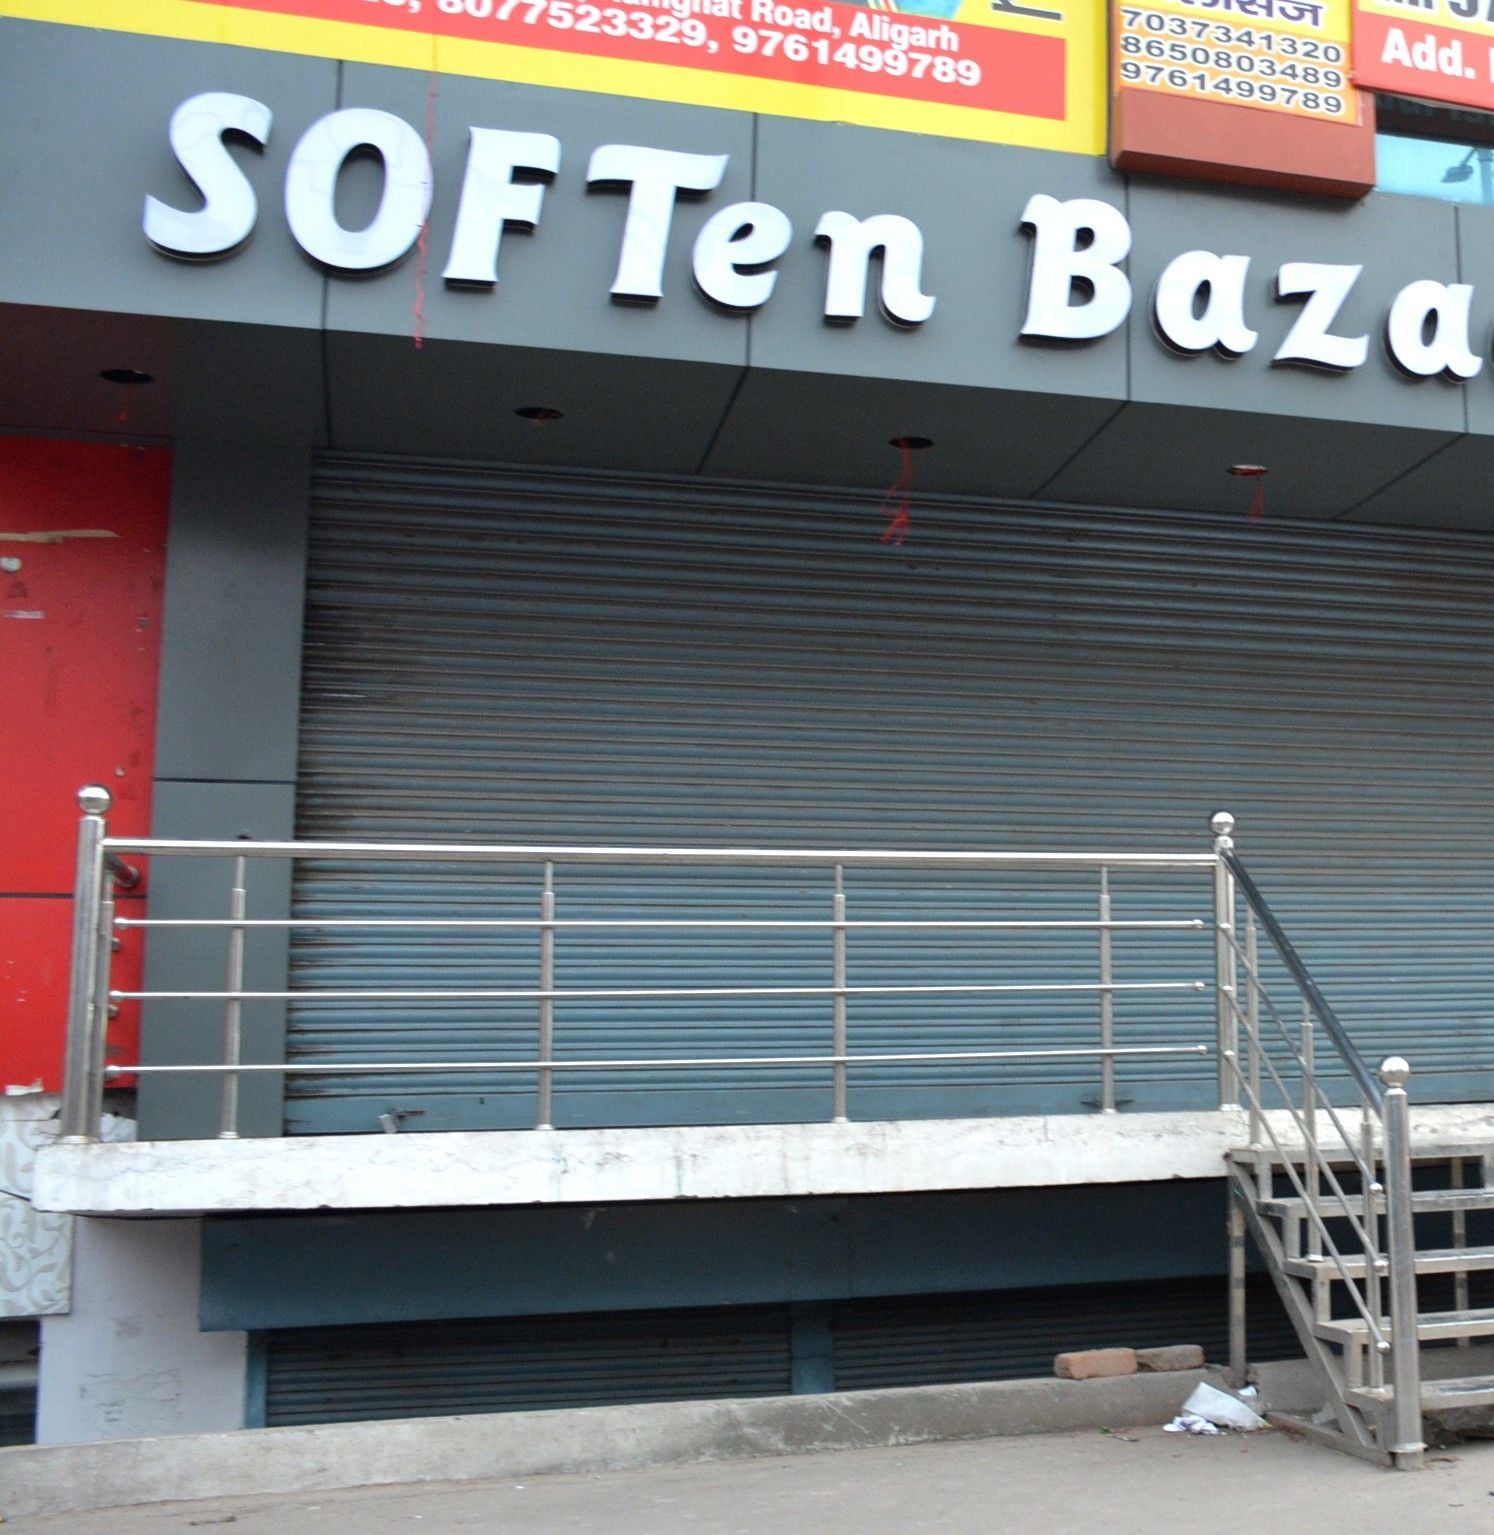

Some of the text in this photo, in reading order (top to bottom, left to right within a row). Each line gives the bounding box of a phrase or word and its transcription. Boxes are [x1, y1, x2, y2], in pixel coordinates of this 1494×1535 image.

[752, 0, 842, 39] Road,
[849, 16, 960, 52] Aligarh
[1120, 8, 1342, 63] 7037341320
[731, 25, 981, 86] 9761499789
[1120, 35, 1342, 88] 8650803489
[1381, 27, 1476, 79] Add.
[1120, 61, 1343, 113] 9761499789
[143, 91, 938, 326] SOFTen
